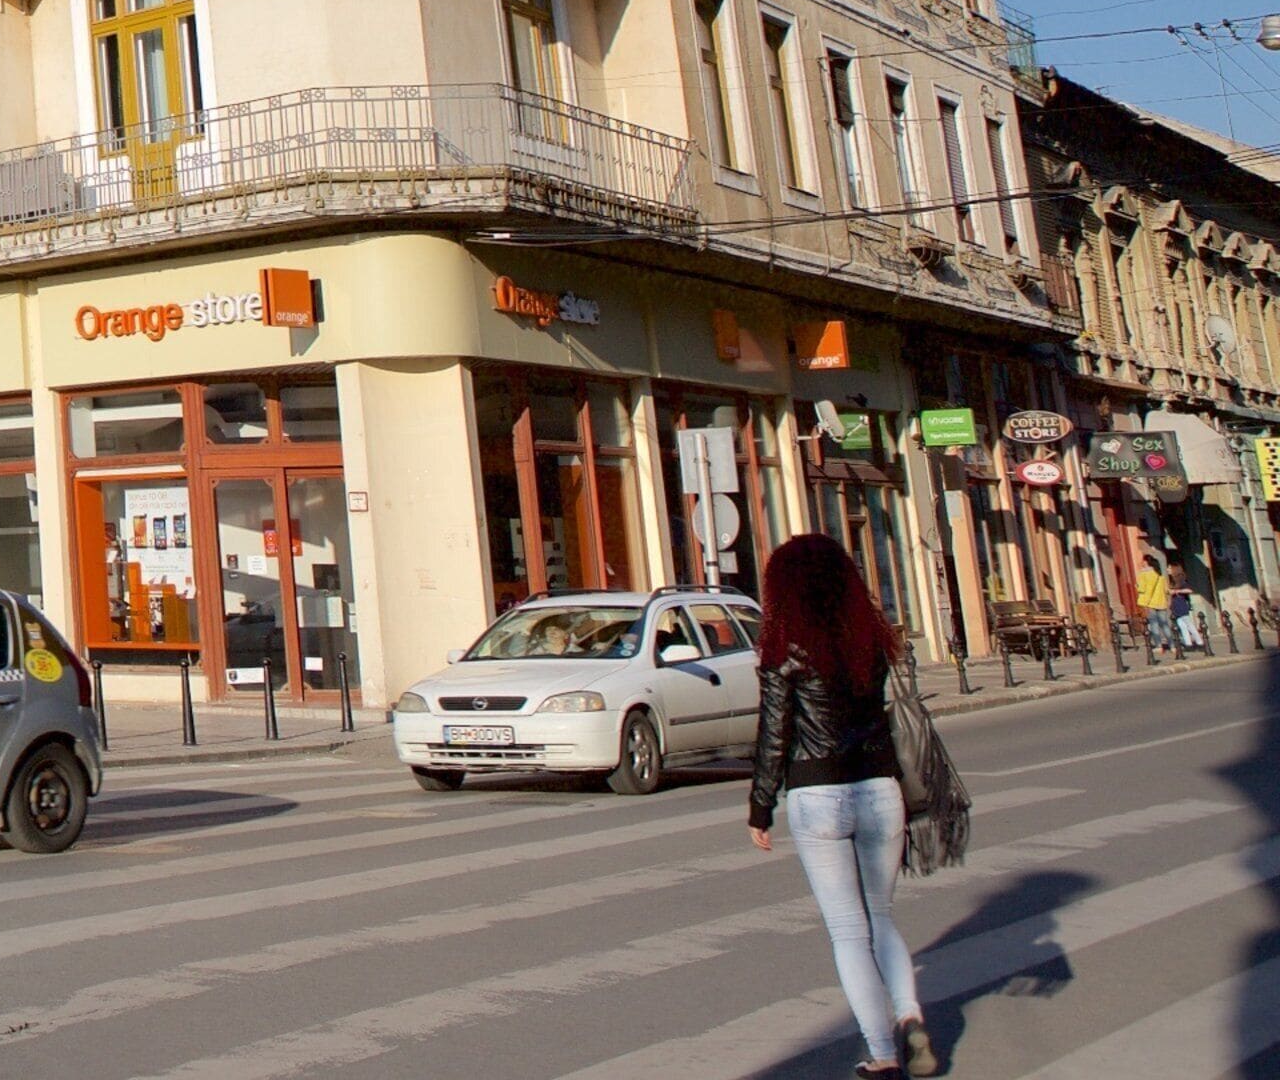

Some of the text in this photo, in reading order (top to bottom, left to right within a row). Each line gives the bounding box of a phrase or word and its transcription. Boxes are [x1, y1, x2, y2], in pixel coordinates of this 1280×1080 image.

[496, 275, 559, 327] Orange
[75, 291, 263, 341] Orange store
[276, 311, 308, 324] orange
[799, 354, 841, 367] orange
[1010, 418, 1059, 428] COFFEE
[1015, 427, 1058, 439] STORE
[1132, 437, 1164, 451] Sex
[1098, 457, 1139, 472] Shop
